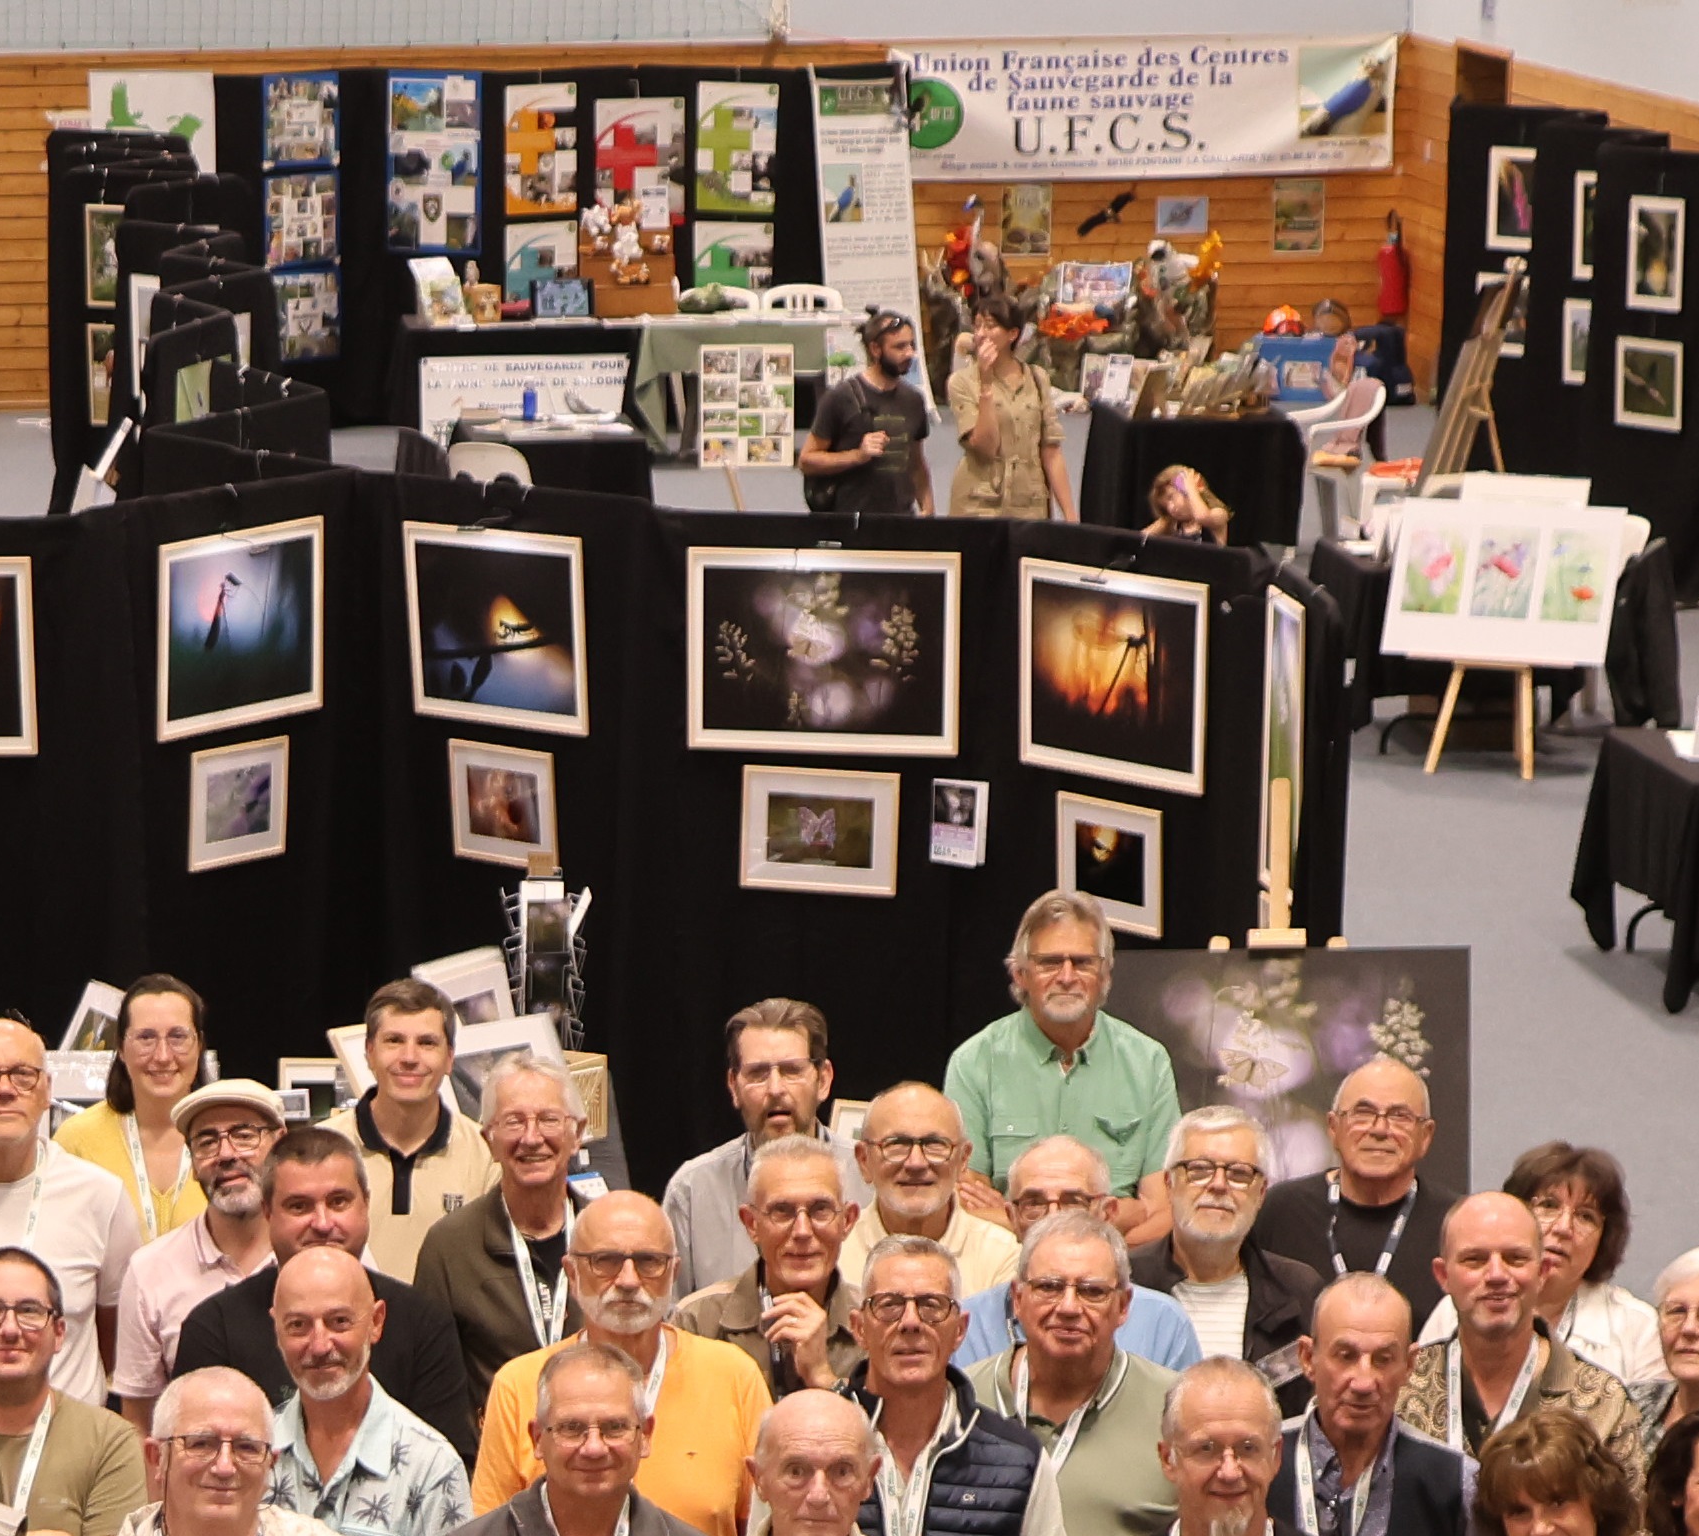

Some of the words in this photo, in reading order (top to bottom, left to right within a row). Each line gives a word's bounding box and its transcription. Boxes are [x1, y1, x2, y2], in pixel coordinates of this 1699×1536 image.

[914, 52, 991, 74] Union
[1002, 48, 1128, 77] Française
[1138, 46, 1180, 67] des
[1191, 44, 1289, 66] Centres
[968, 72, 998, 92] de
[1008, 68, 1175, 93] Sauvegarde
[1180, 67, 1200, 87] de
[1209, 65, 1233, 86] la
[1007, 91, 1081, 112] faune
[1091, 90, 1194, 113] sauvage
[1014, 111, 1206, 157] U.F.C.S.
[591, 360, 624, 370] POUR
